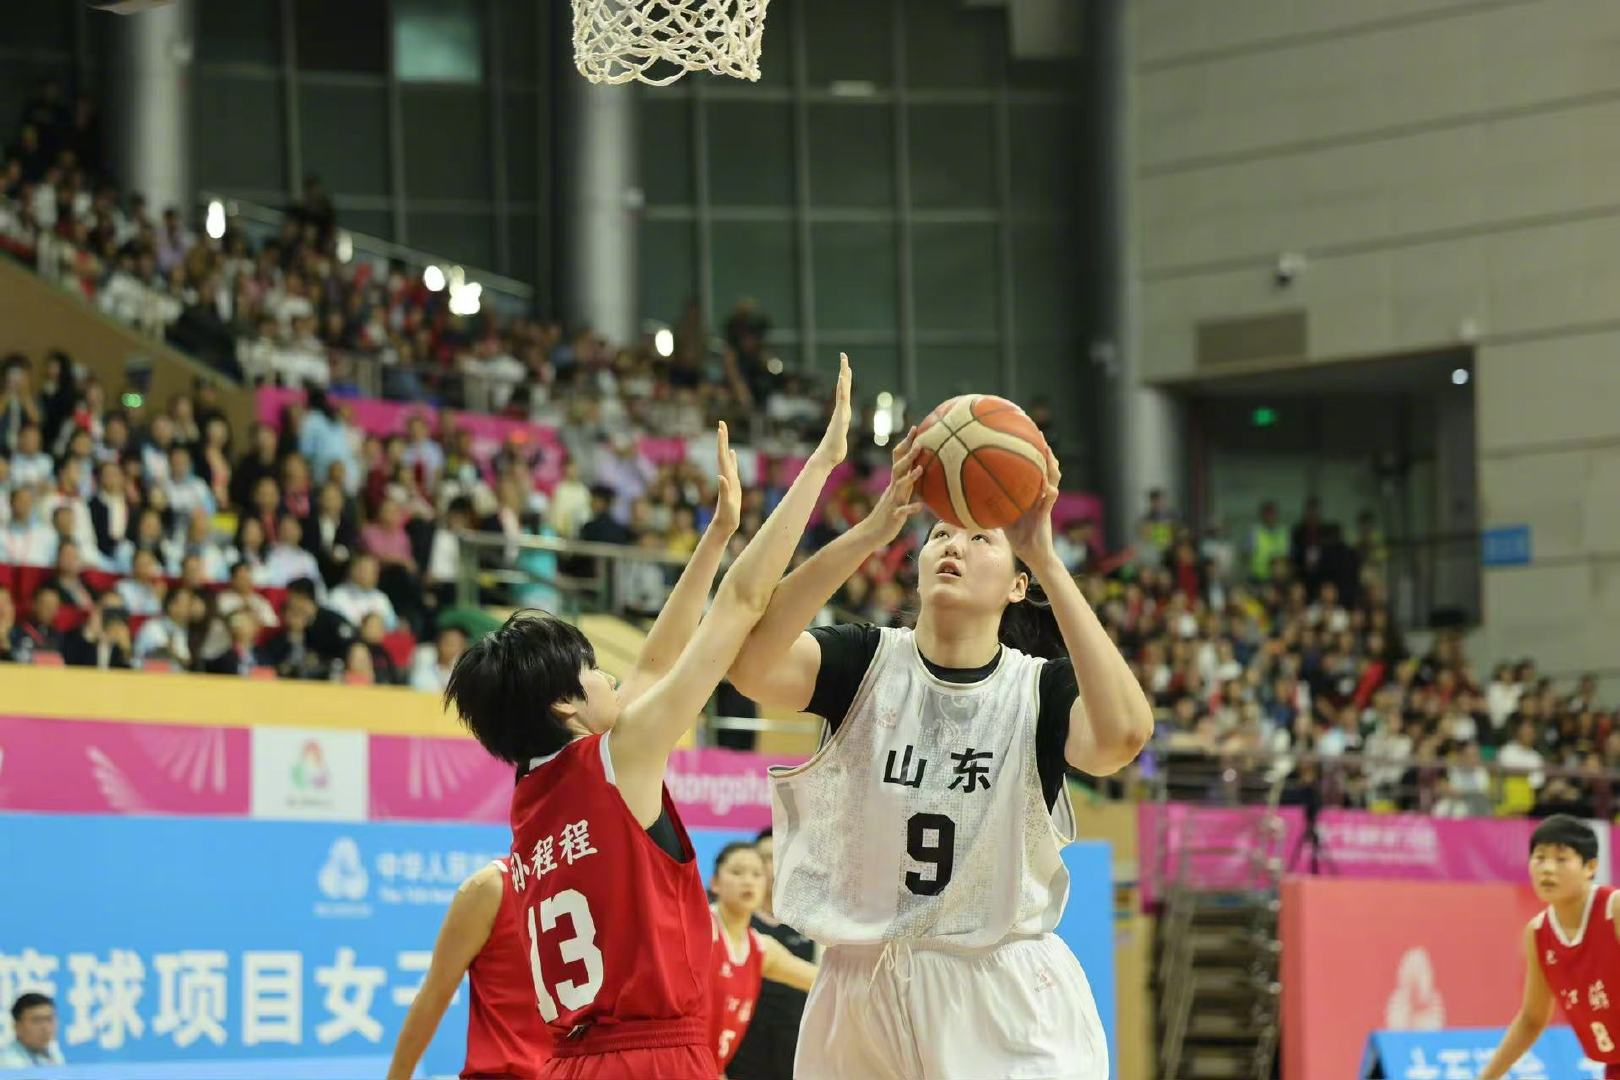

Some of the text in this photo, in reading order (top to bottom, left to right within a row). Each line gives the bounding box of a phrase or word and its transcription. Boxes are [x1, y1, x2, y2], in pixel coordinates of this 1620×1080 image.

[883, 744, 994, 793] 山东
[511, 819, 598, 893] 孙程程
[905, 812, 956, 896] 9
[528, 888, 604, 1023] 13
[1590, 1021, 1616, 1053] 8
